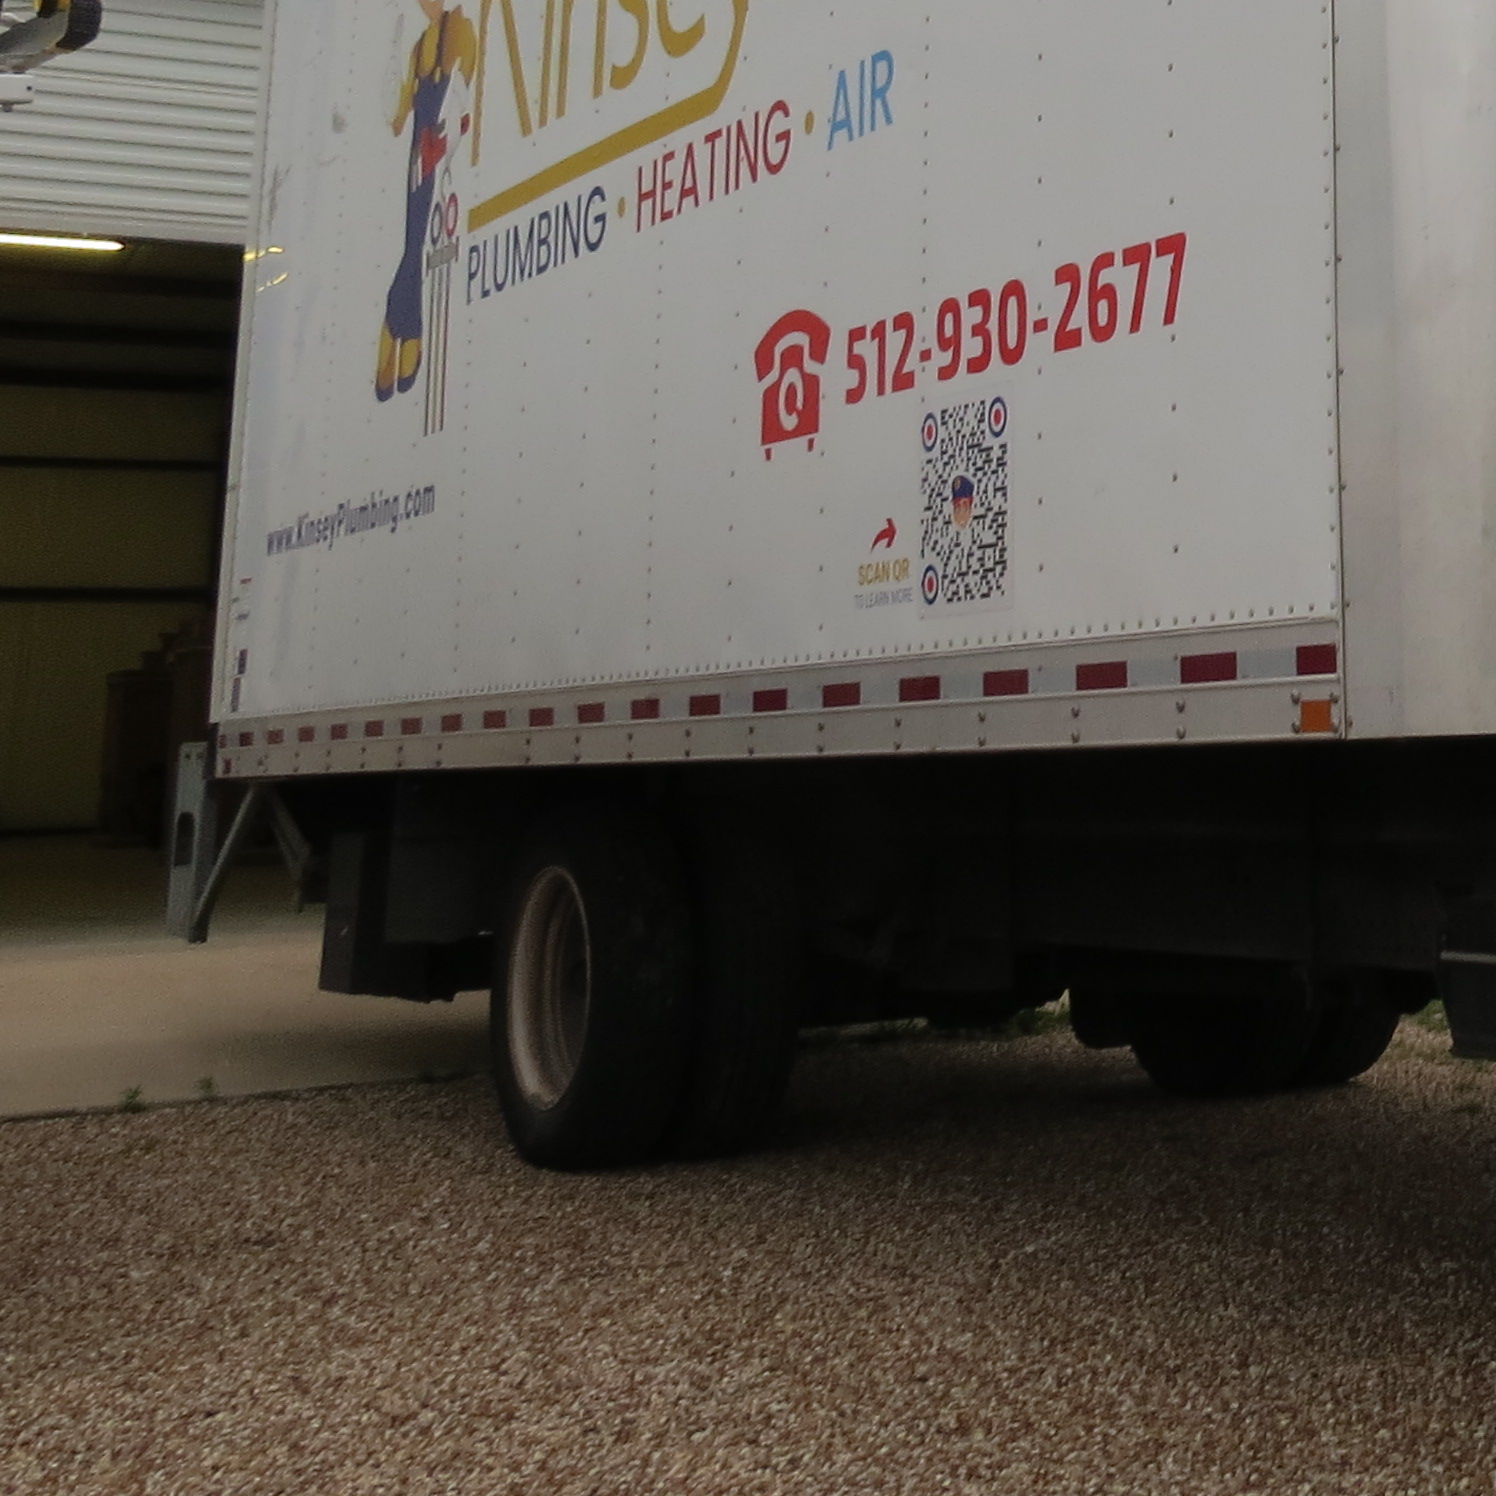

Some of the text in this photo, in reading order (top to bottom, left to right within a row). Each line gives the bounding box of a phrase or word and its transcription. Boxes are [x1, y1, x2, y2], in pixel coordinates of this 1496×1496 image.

[466, 49, 894, 305] PLUMBING HEATING AIR
[844, 232, 1187, 405] 512-930-2677
[858, 558, 909, 585] SCAN QR
